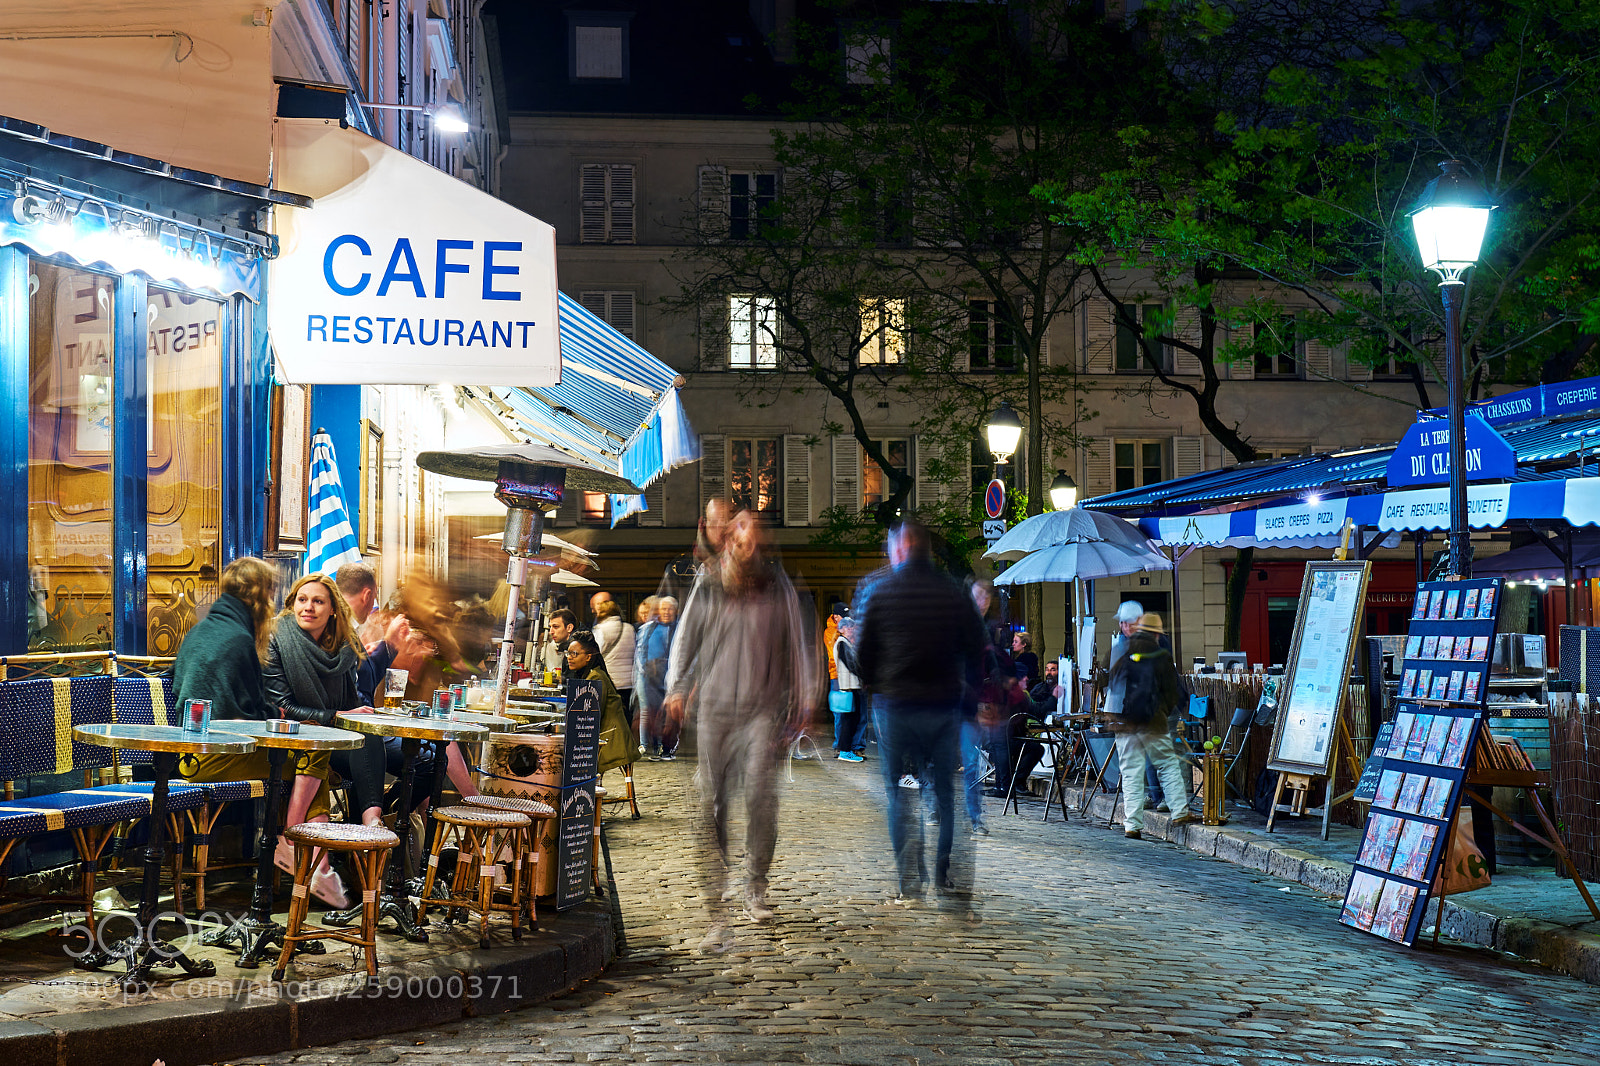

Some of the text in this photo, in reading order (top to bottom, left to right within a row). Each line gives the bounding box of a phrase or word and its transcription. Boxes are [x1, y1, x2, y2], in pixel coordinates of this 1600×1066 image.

[323, 235, 523, 300] CAFE
[307, 315, 535, 349] RESTAURANT
[1557, 387, 1598, 406] CREPERIE
[1487, 398, 1532, 419] CHASSEURS
[1420, 432, 1430, 447] LA
[1411, 455, 1426, 476] DU
[1265, 511, 1333, 529] GLACES CREPES PIZZA
[1386, 505, 1404, 518] CAFE
